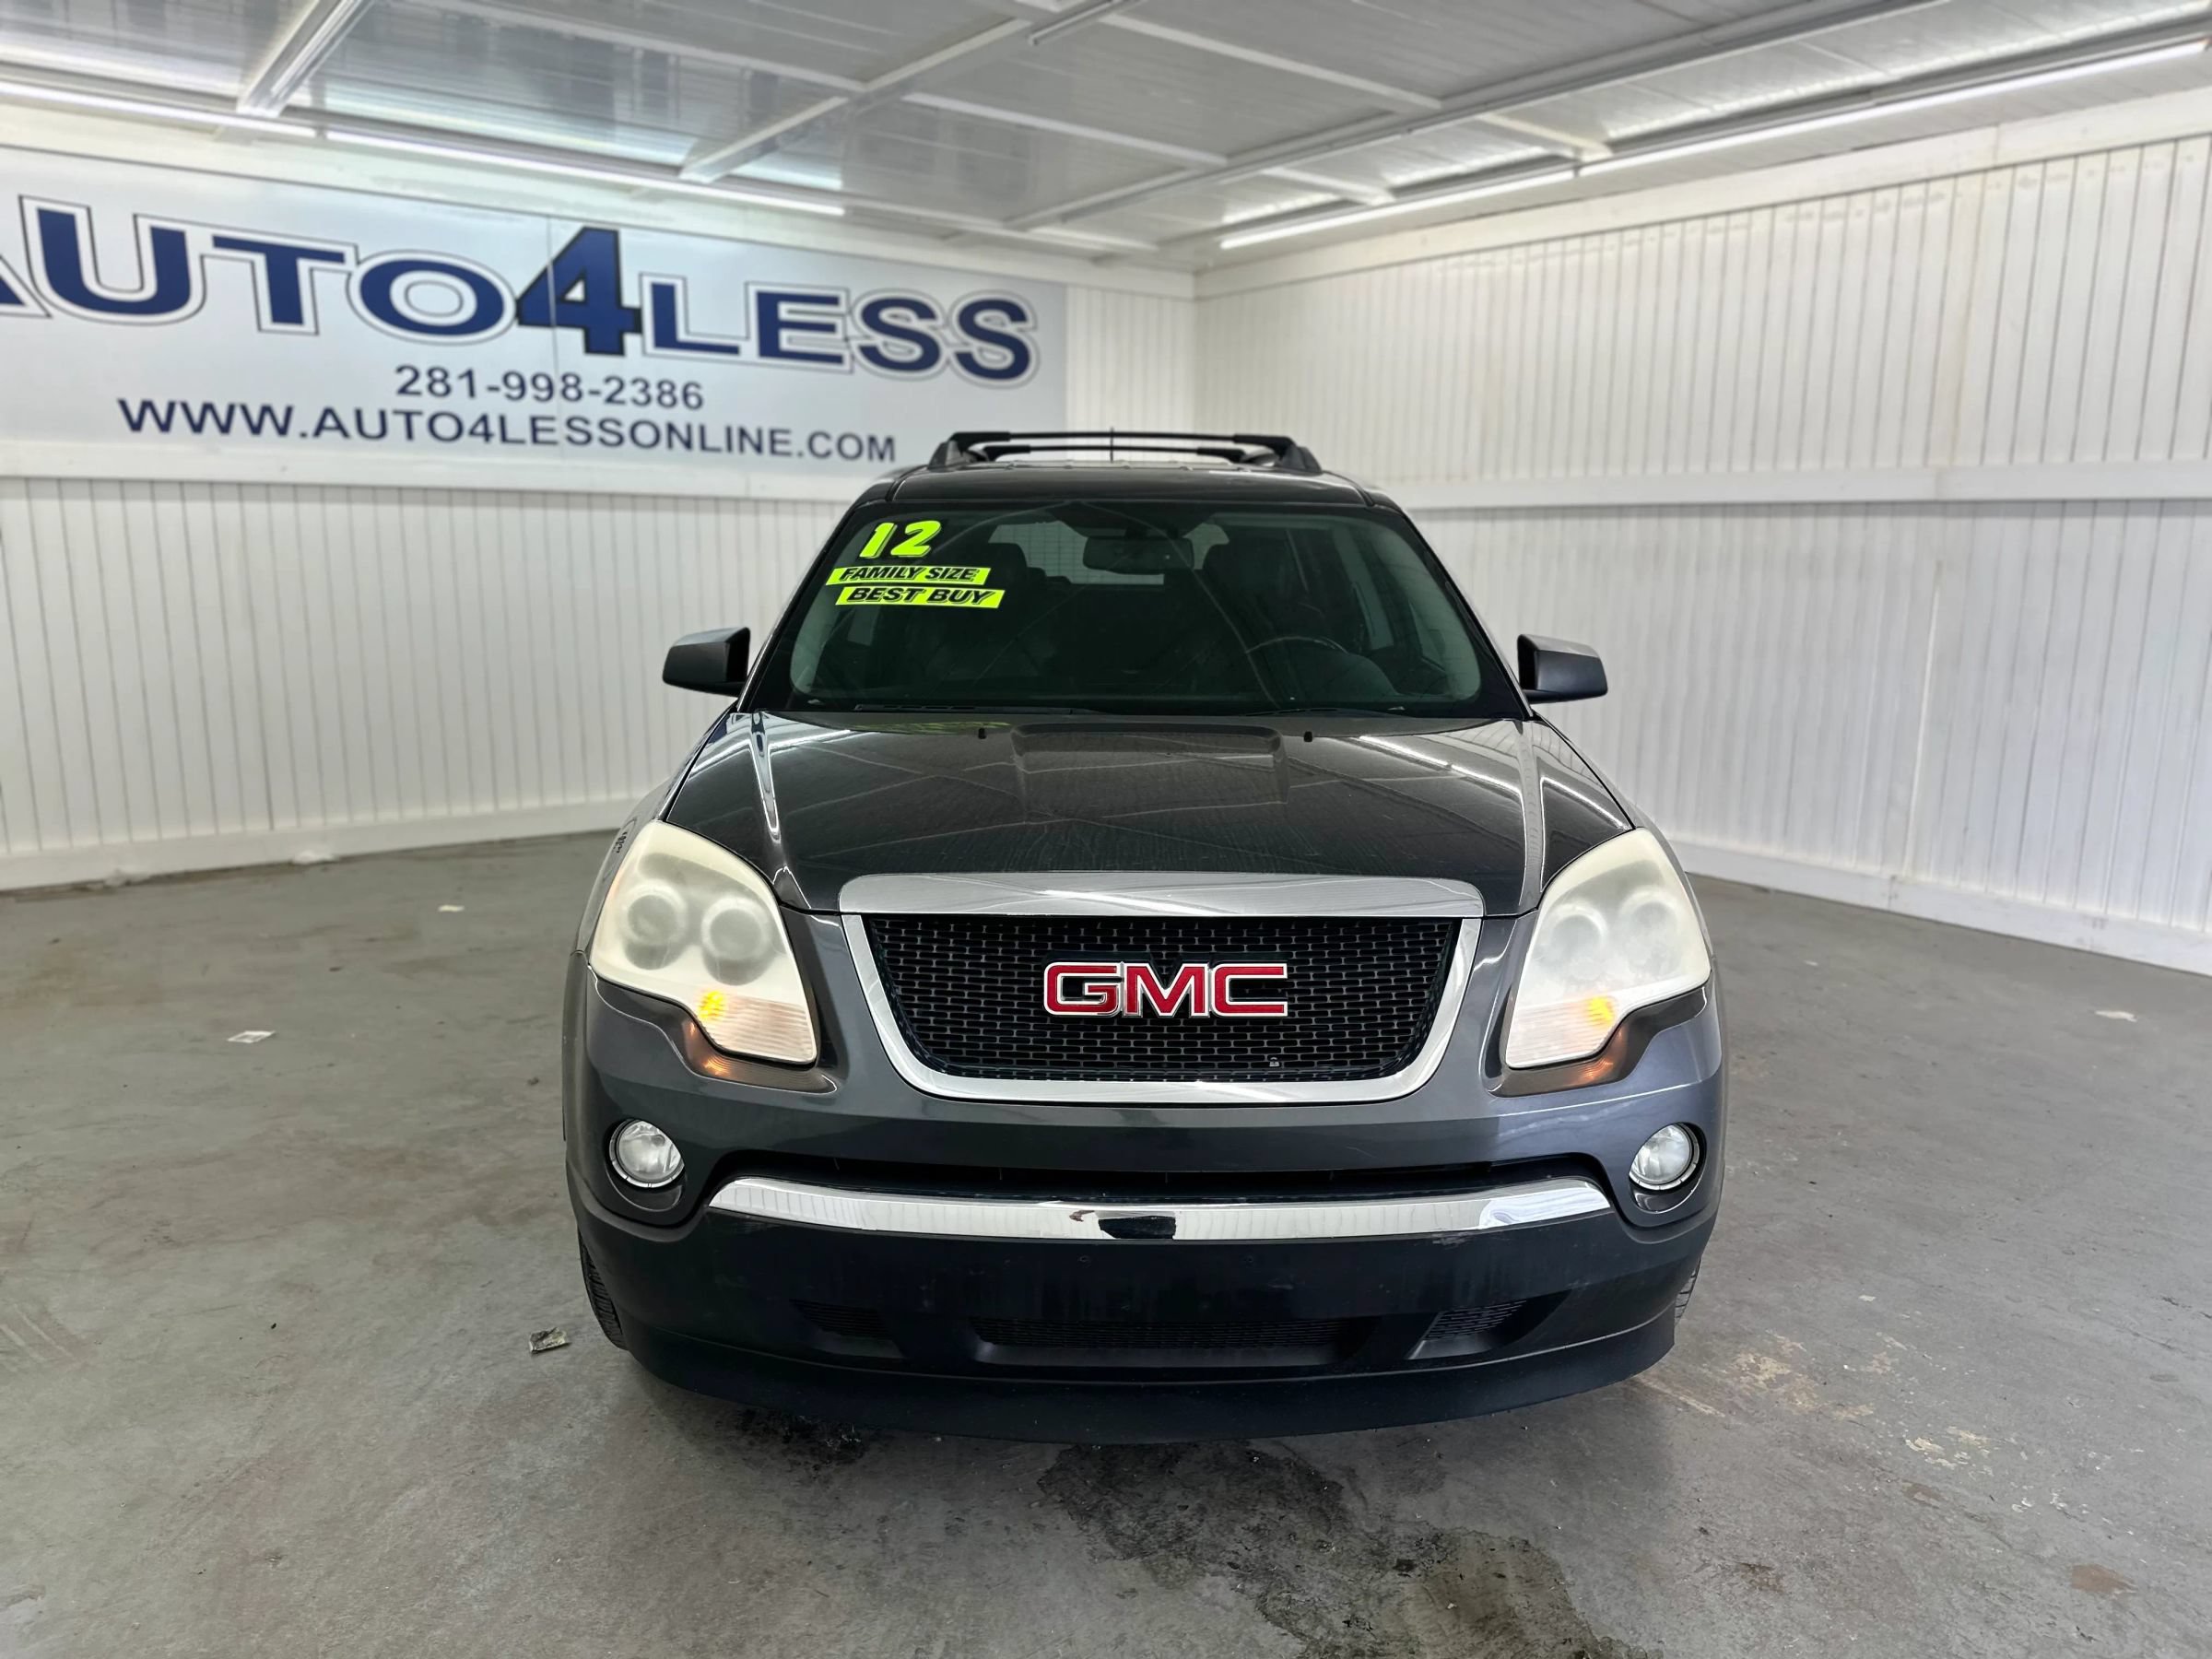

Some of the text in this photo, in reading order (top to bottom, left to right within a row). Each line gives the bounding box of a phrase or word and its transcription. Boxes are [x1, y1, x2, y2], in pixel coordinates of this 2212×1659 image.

[395, 365, 703, 410] 281-998-2386
[118, 398, 896, 463] WWW.AUTO4LESSONLINE.COM
[859, 520, 942, 559] 12
[840, 566, 978, 582] FAMILY SIZE
[847, 587, 994, 606] BEST BUY
[1043, 961, 1288, 1018] GMC
